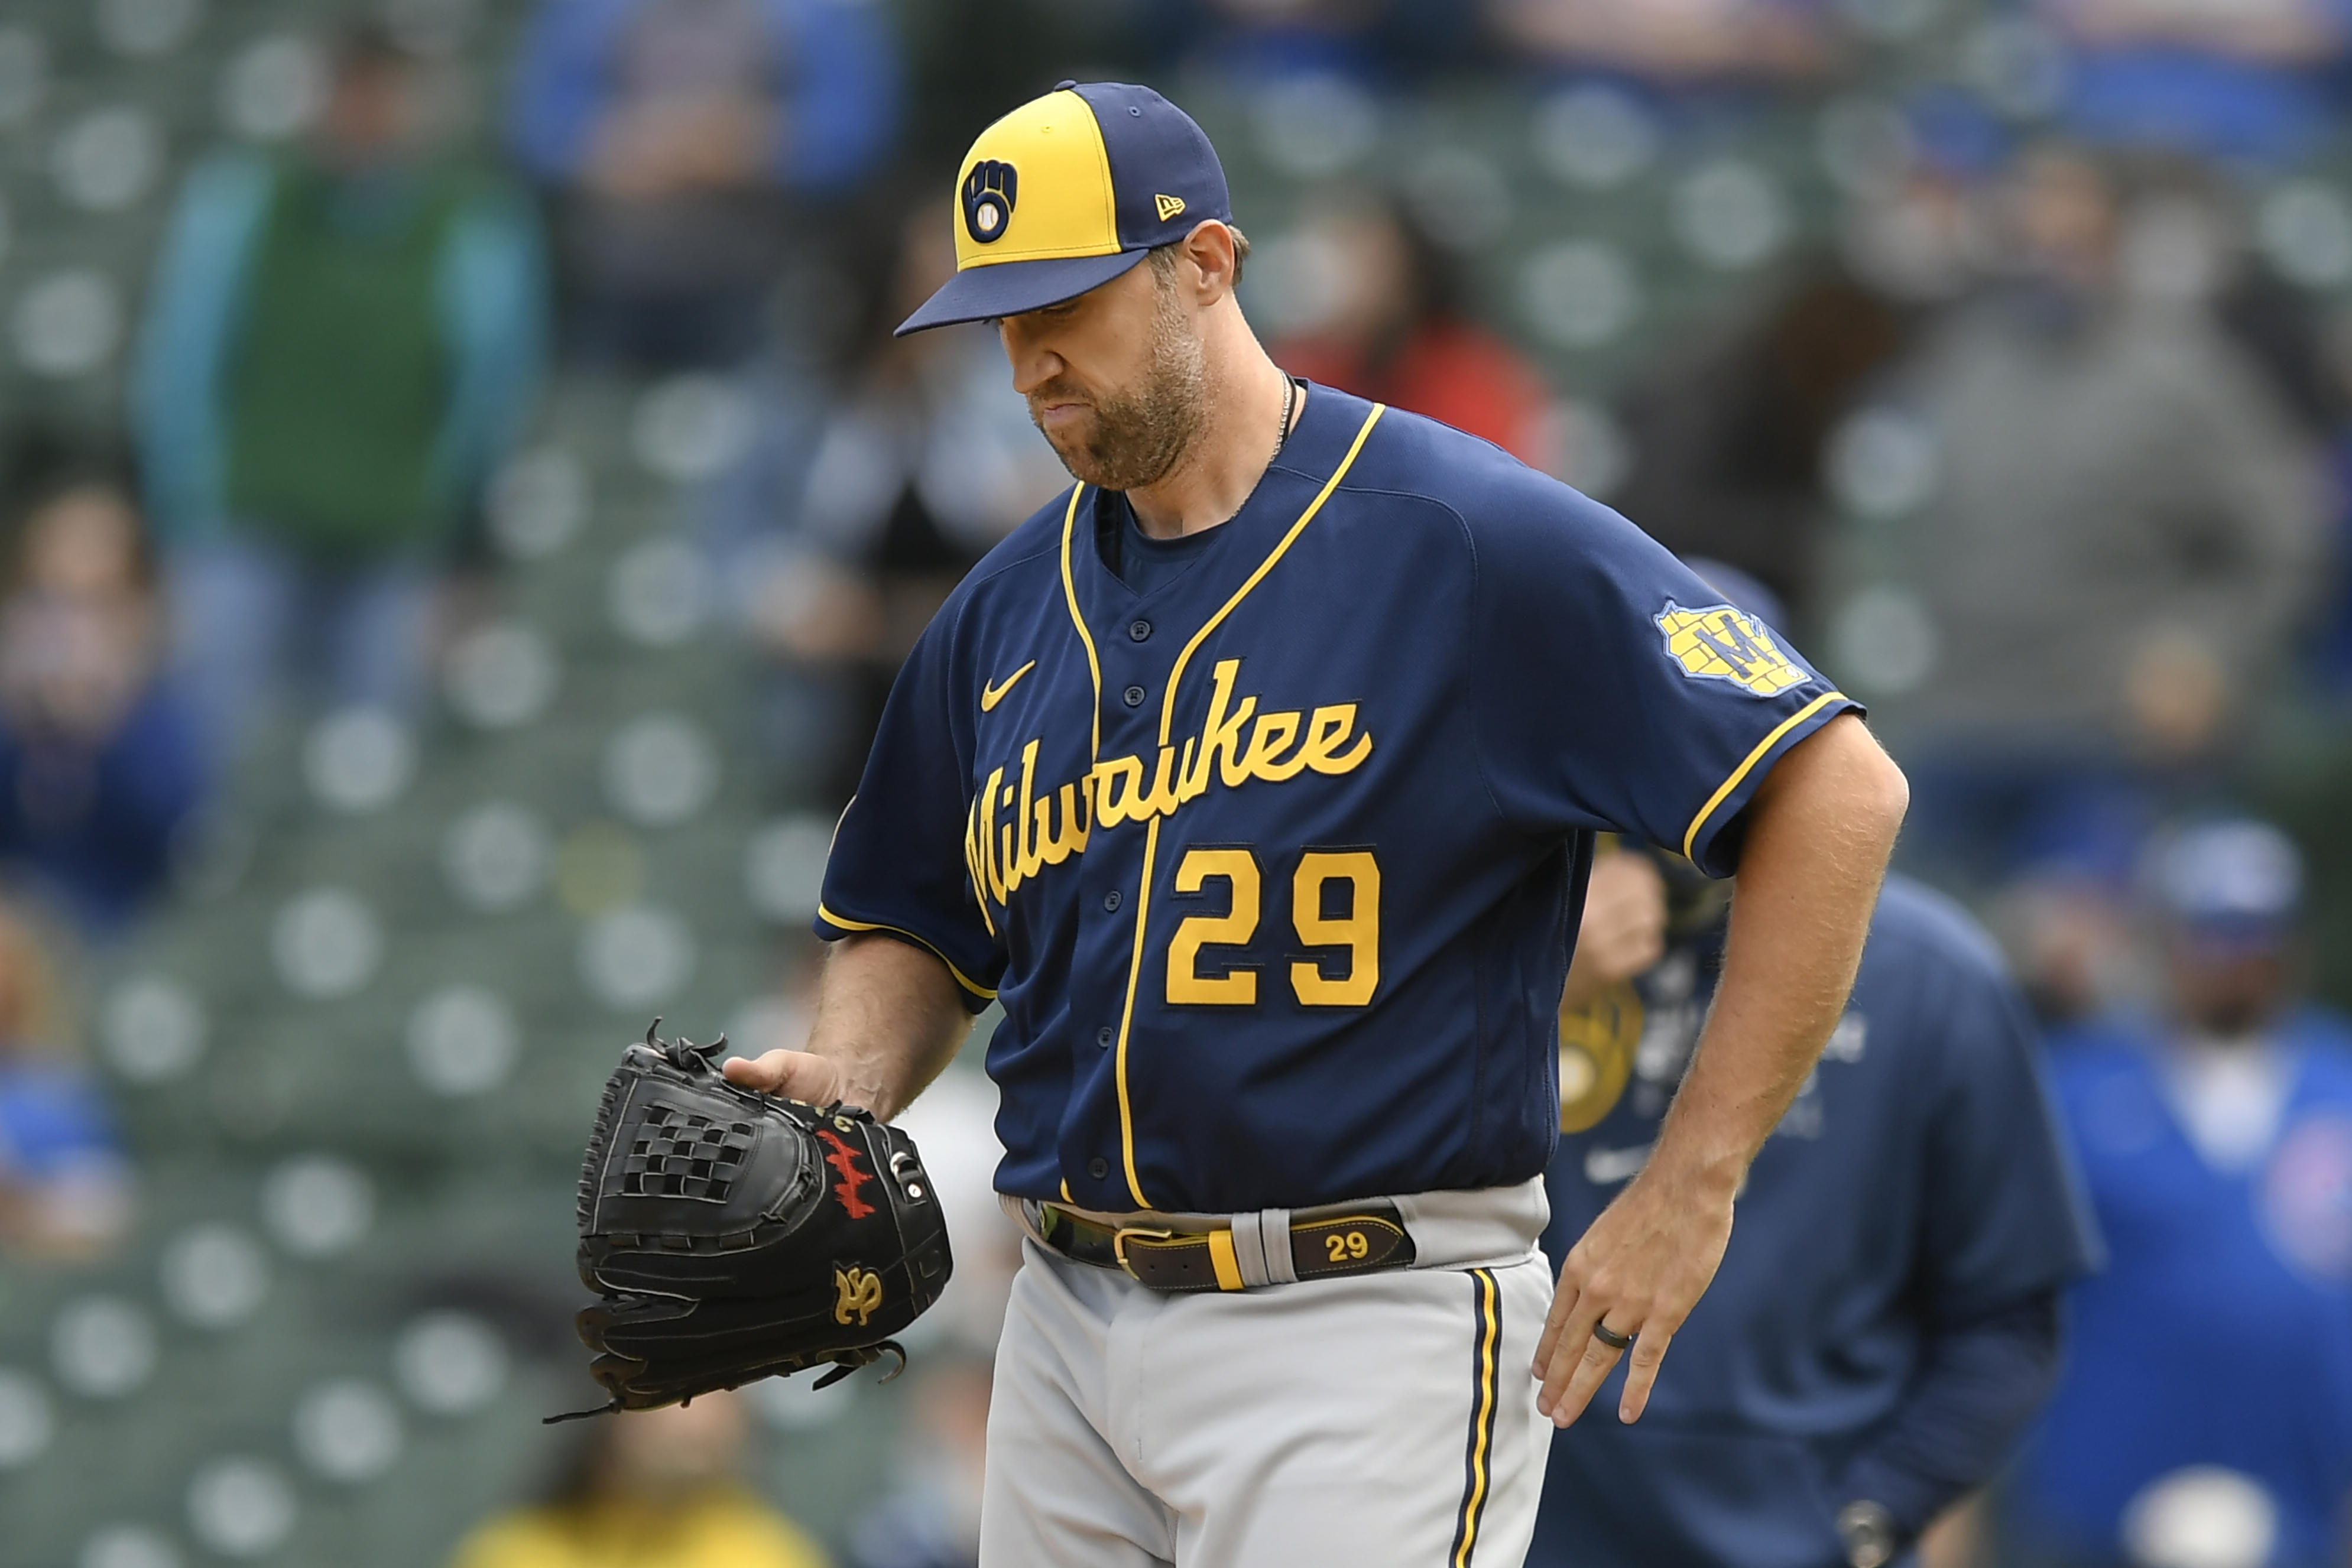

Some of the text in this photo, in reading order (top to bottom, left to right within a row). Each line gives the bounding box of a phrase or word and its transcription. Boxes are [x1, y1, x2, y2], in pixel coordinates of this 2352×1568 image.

[1692, 613, 1778, 680] M
[964, 658, 1373, 937] Milwaukee
[1166, 849, 1381, 1006] 29
[1325, 1232, 1368, 1262] 29
